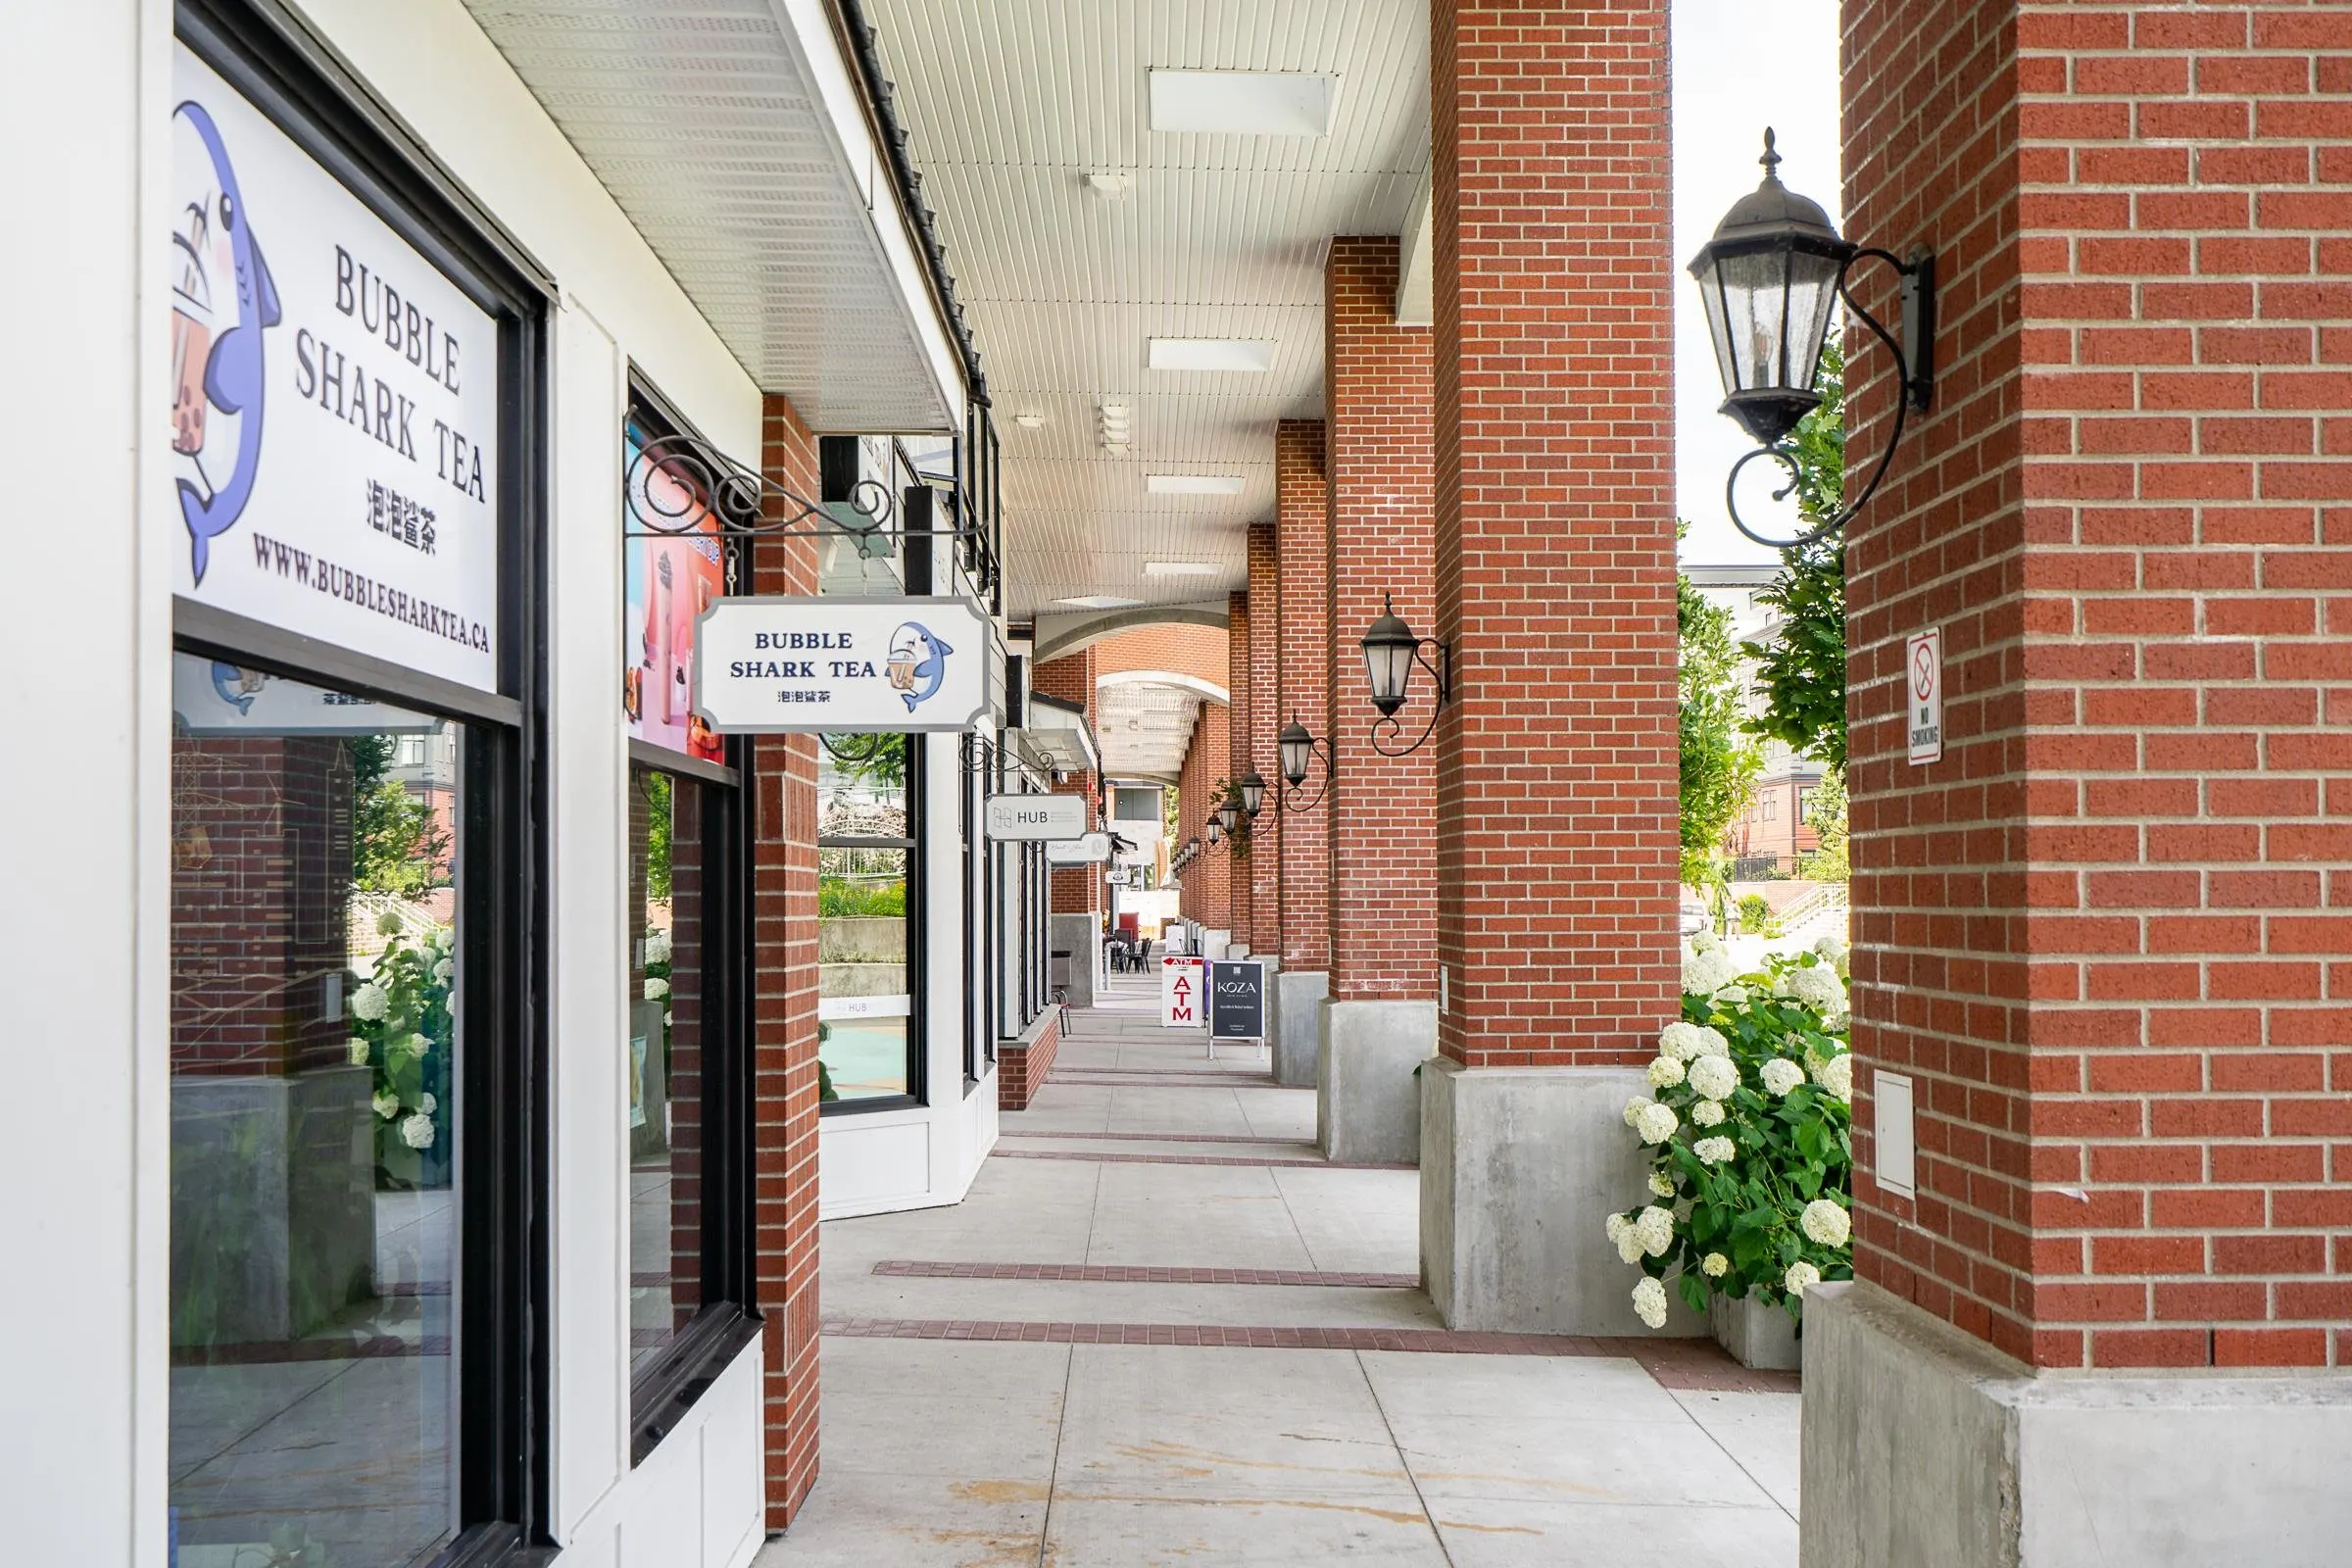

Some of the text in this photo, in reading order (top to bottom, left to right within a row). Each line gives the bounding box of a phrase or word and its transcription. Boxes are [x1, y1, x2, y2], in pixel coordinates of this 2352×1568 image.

[335, 243, 461, 397] BUBBLE
[296, 327, 486, 505] SHARK TEA
[366, 477, 436, 557] 泡泡鲨茶
[253, 531, 490, 654] WWW.BUBBLESHARKTEA.CA
[755, 632, 854, 650] BUBBLE
[730, 661, 877, 678] SHARK TEA
[1921, 707, 1929, 724] NO
[1912, 726, 1937, 748] SMOKING
[1017, 810, 1049, 824] HUB
[1217, 981, 1256, 994] KOZA
[849, 1003, 867, 1011] HUB
[1172, 975, 1192, 1021] ATM
